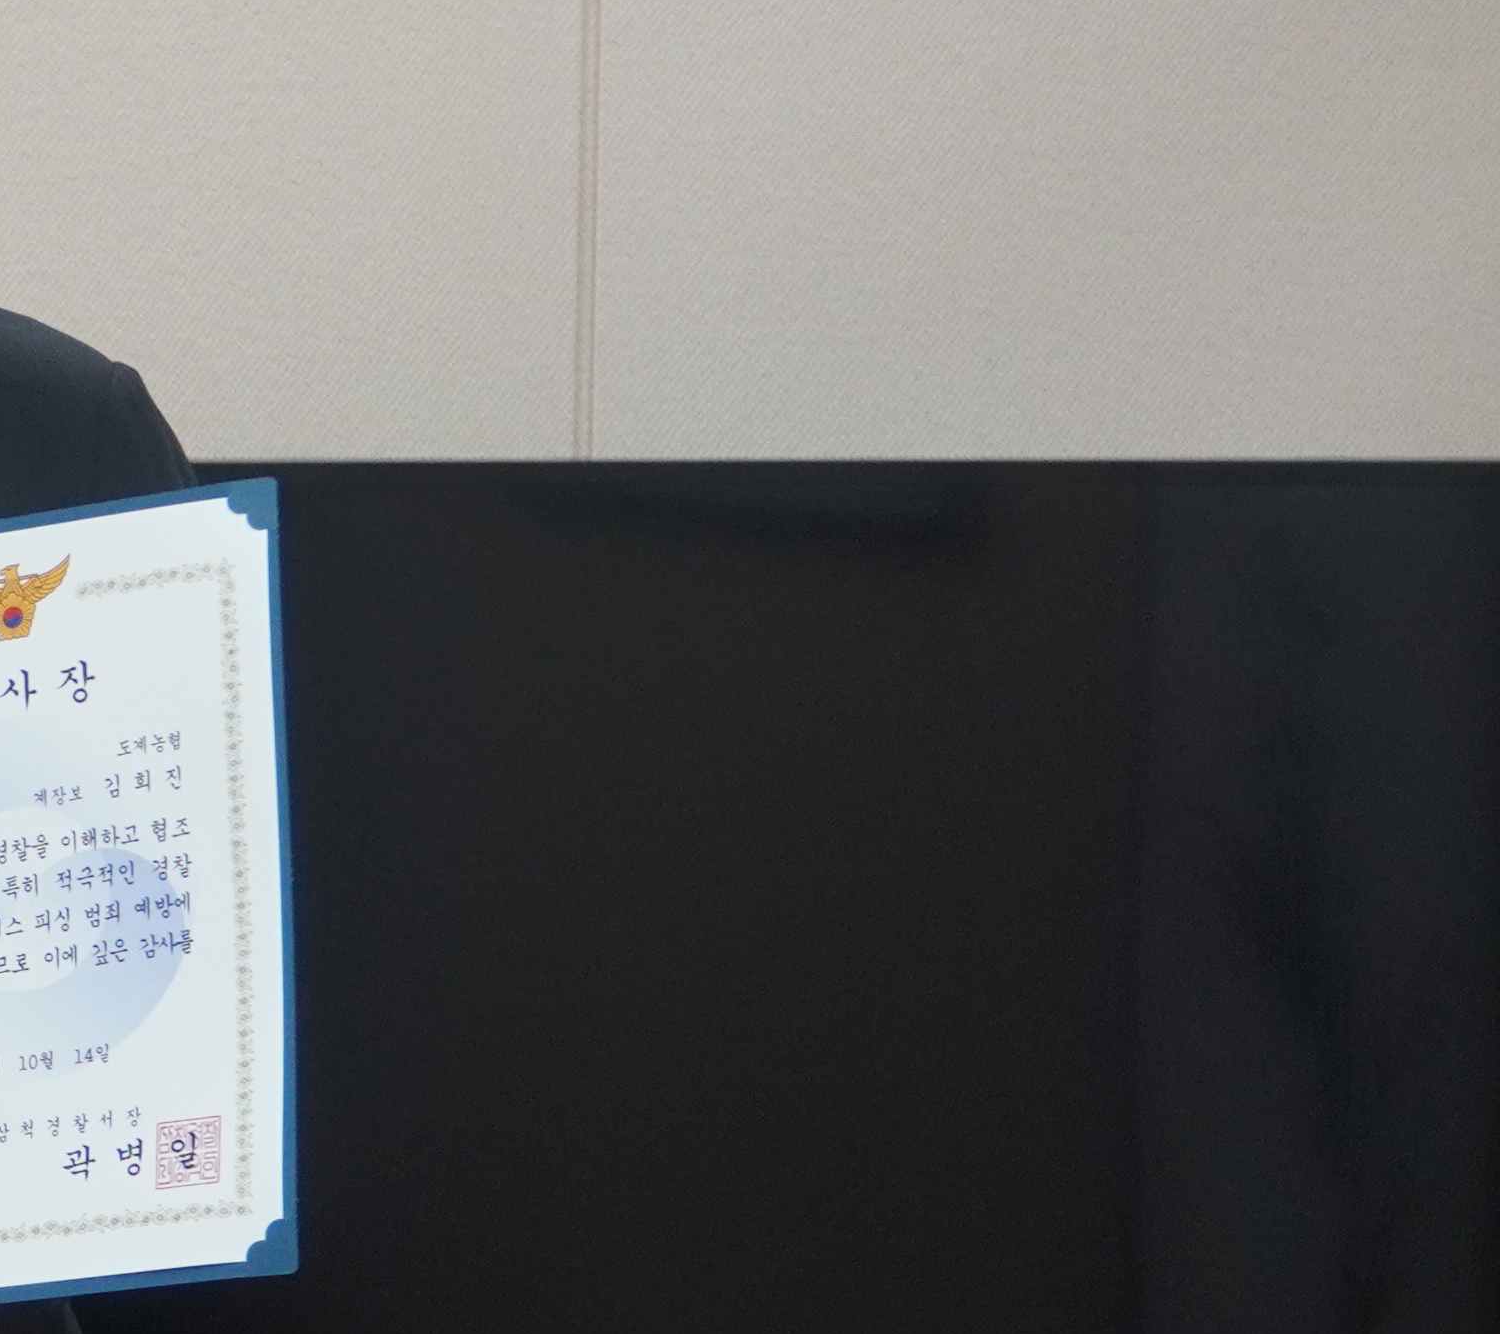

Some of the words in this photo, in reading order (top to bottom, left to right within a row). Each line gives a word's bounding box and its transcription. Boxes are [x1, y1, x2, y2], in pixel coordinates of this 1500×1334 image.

[60, 824, 141, 852] 이해하고
[150, 817, 191, 843] 협조
[1, 873, 39, 900] 특히
[56, 859, 135, 892] 적극적인
[152, 852, 193, 882] 경찰
[34, 906, 71, 933] 피싱
[83, 899, 121, 929] 범죄
[133, 890, 191, 920] 예방에
[43, 943, 78, 969] 이에
[91, 938, 129, 967] 깊은
[139, 928, 195, 959] 감사를
[19, 1050, 54, 1072] 10월
[74, 1042, 109, 1065] 14일
[63, 1131, 197, 1177] 곽병일
